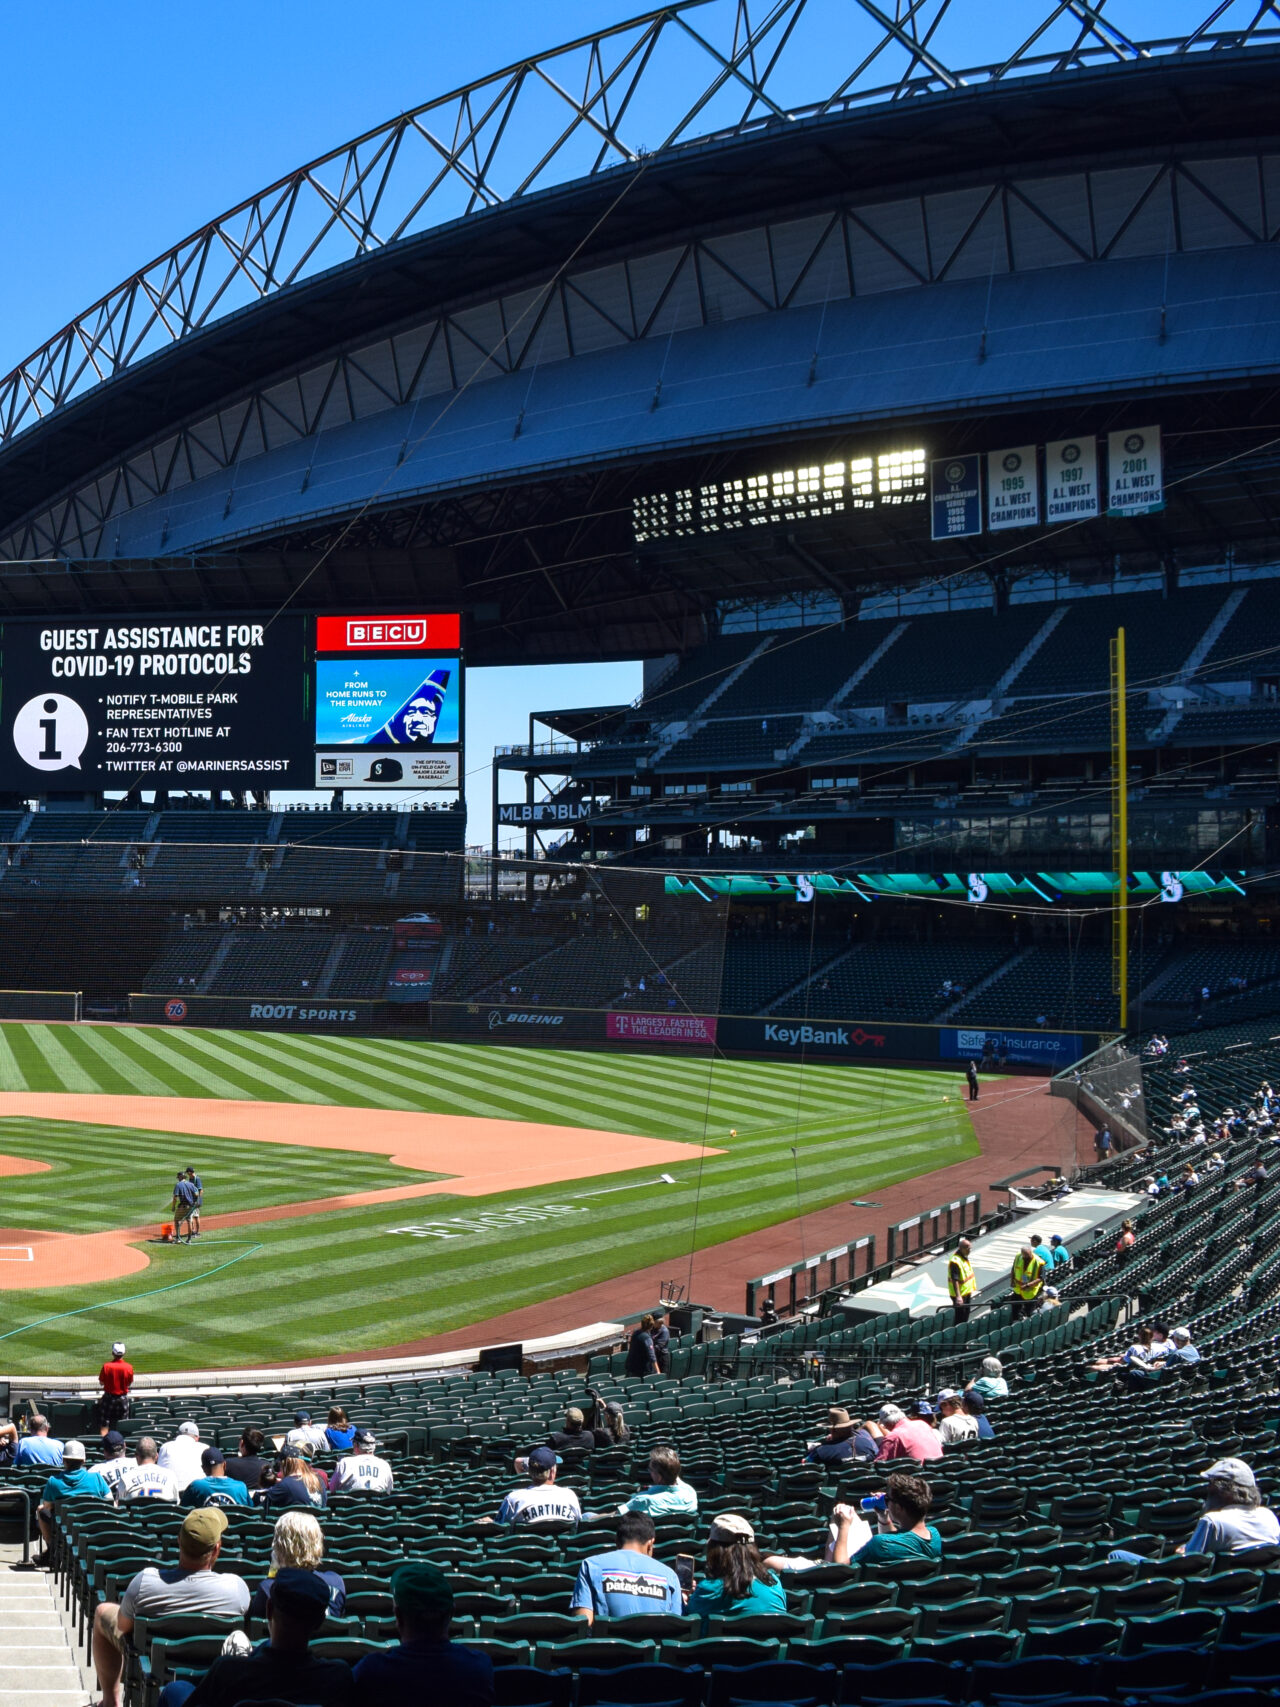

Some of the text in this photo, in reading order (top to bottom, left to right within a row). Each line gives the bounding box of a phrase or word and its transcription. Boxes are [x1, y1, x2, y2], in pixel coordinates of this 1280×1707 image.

[1123, 458, 1148, 474] 2001
[1060, 467, 1083, 483] 1997
[1132, 474, 1155, 488] WEST
[1001, 476, 1024, 492] 1995
[1068, 484, 1091, 497] WEST
[1009, 492, 1031, 505] WEST
[1111, 489, 1160, 507] CHAMPIONS
[1049, 498, 1096, 516] CHAMPIONS
[991, 506, 1036, 523] CHAMPIONS
[40, 625, 264, 650] GUEST ASSISTANCE FOR
[353, 625, 420, 640] BECU
[51, 653, 252, 677] COVID-19 PROTOCOLS
[106, 693, 238, 705] NOTIFY T-MOBILE PARK
[106, 708, 212, 720] REPRESENTATIVES
[340, 713, 373, 724] Alaska
[106, 727, 231, 738] FAN TEXT HOTLINE AT
[106, 742, 182, 753] 206-773-6300
[106, 760, 289, 772] TWITTER AT @MARINERSASSIST
[500, 803, 591, 821] MLB BLM
[167, 1003, 185, 1016] 76
[250, 1004, 357, 1021] ROOT SPORTS
[506, 1013, 564, 1025] BOEING
[632, 1025, 707, 1038] THE LEADER IN 5G
[764, 1025, 849, 1046] KeyBank
[1003, 1036, 1061, 1050] Insurance
[358, 1465, 379, 1478] DAD
[131, 1473, 168, 1487] SEAGER
[521, 1503, 574, 1521] MARTINEZ
[605, 1581, 664, 1598] patagonia
